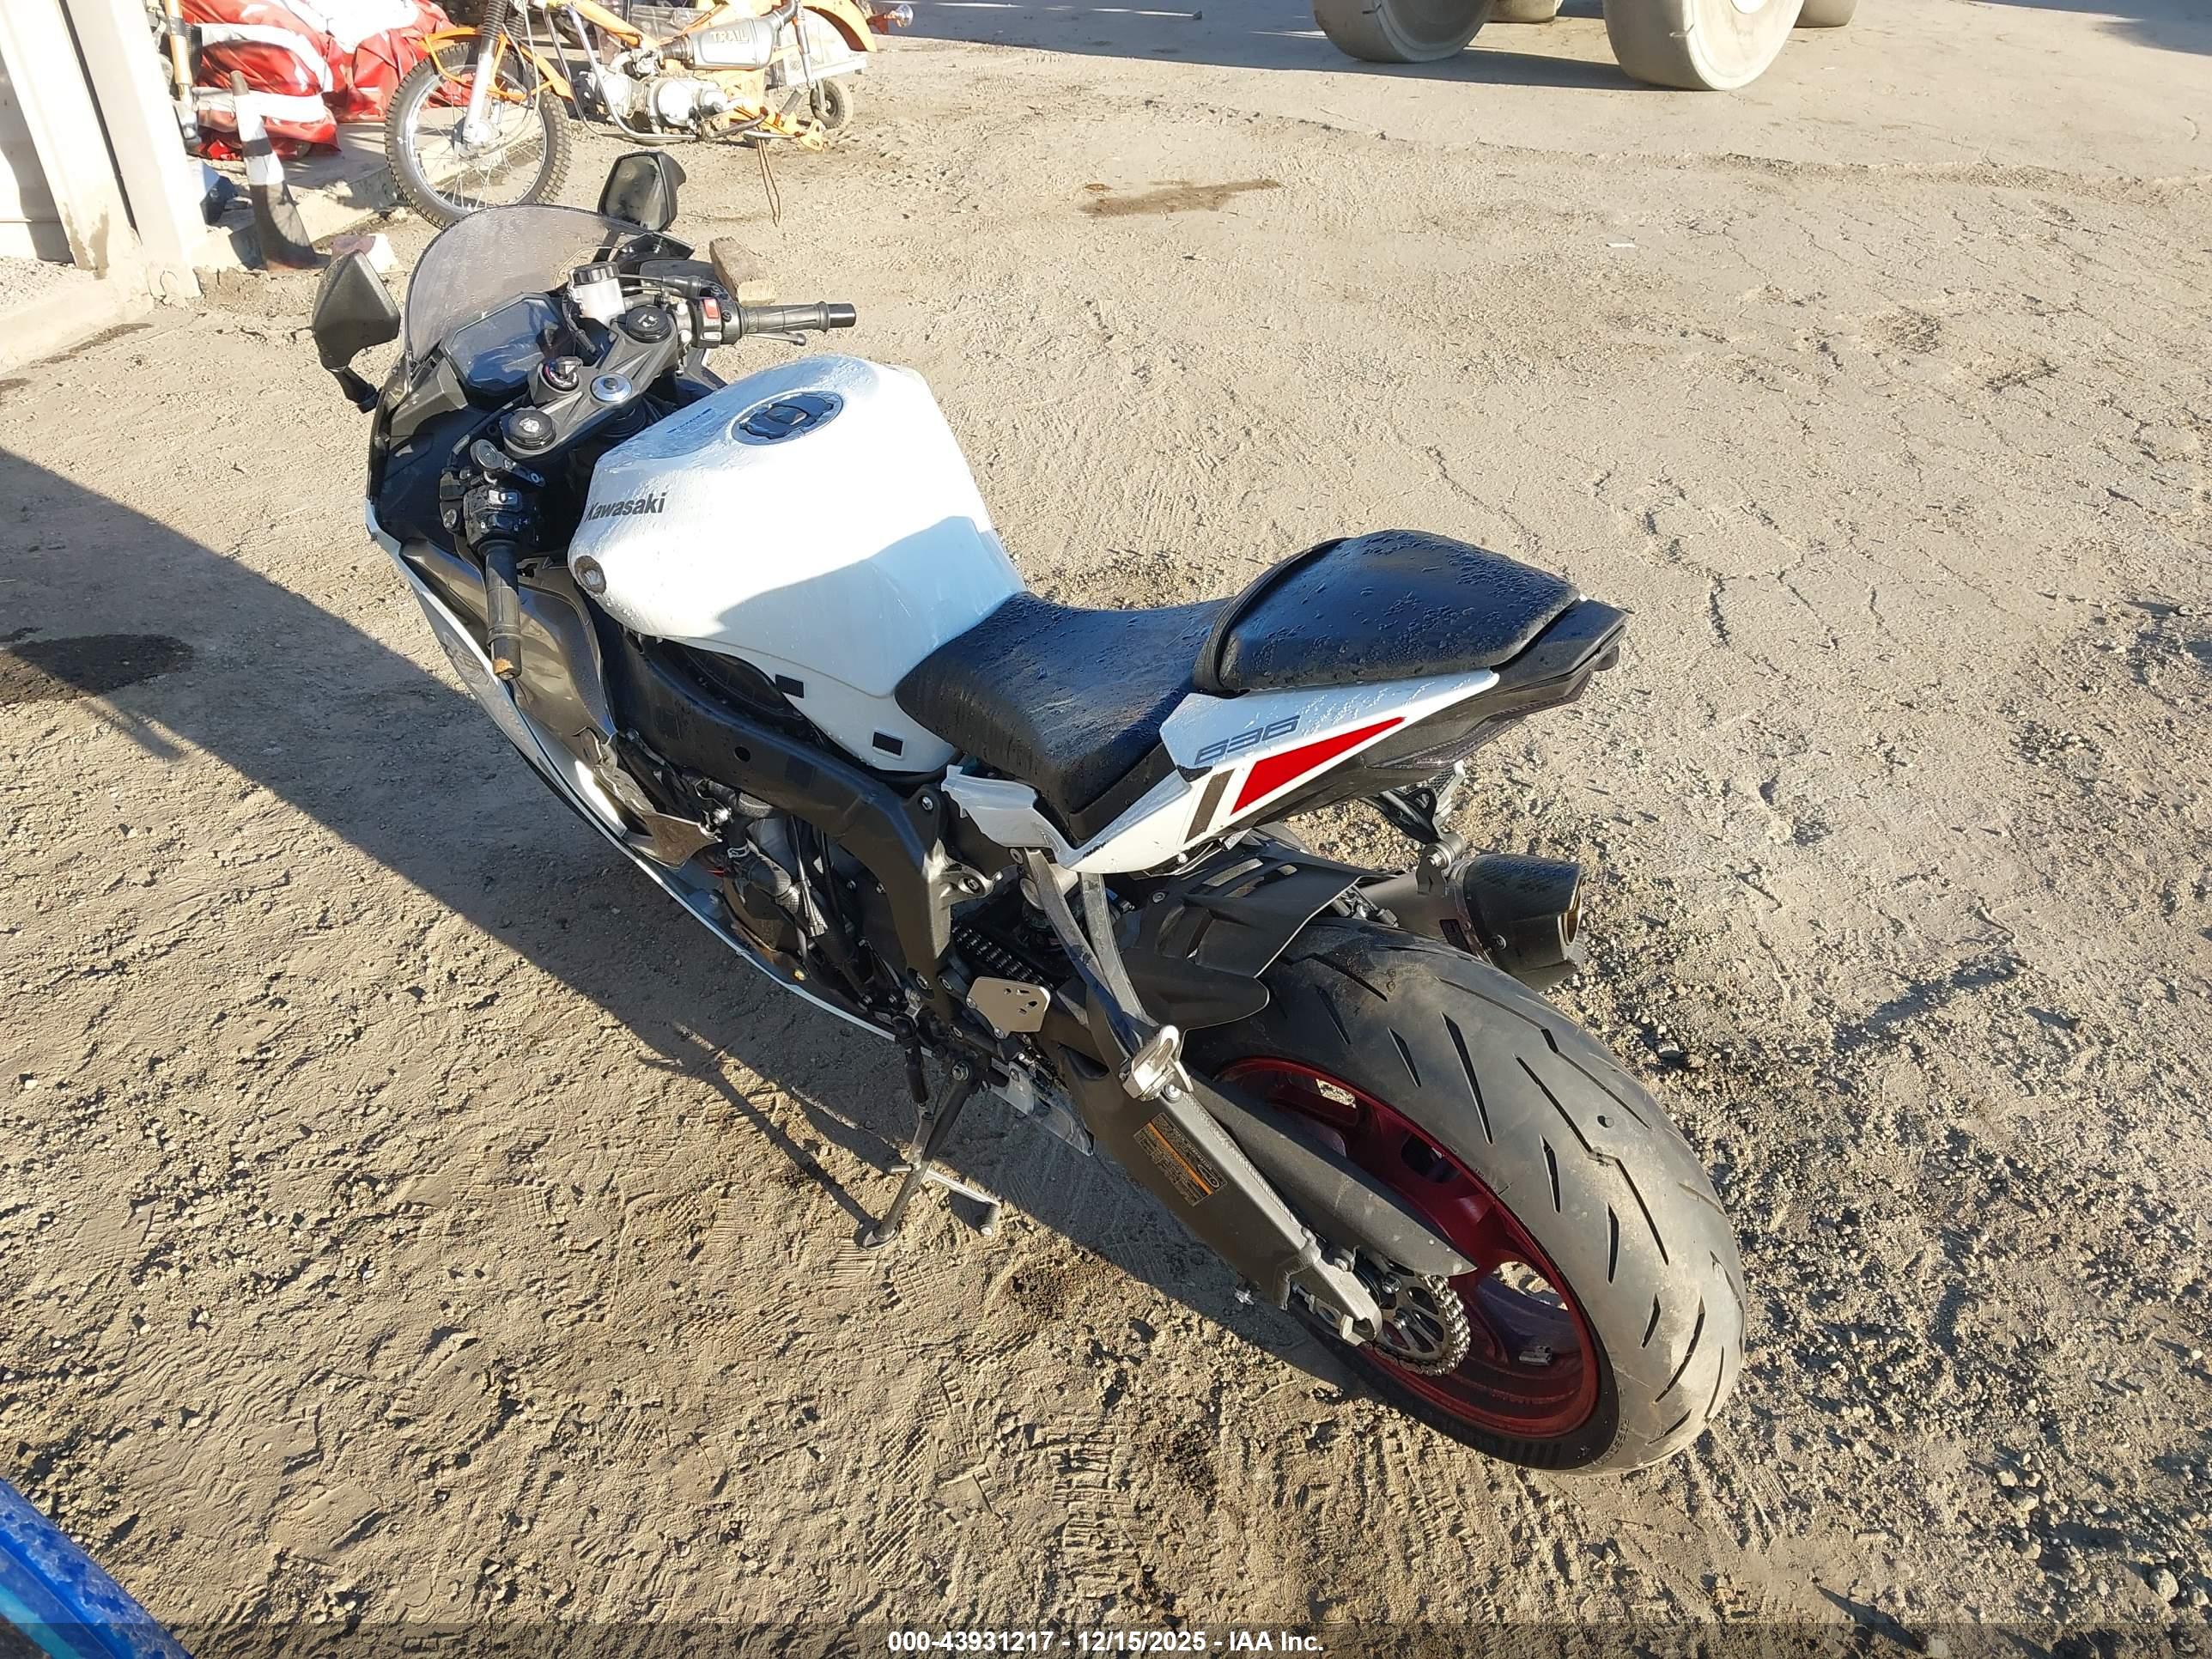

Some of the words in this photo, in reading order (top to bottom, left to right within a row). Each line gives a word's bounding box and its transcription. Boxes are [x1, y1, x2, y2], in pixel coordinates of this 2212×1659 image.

[709, 29, 750, 44] TRAIL
[585, 492, 666, 522] Kawasaki
[1194, 714, 1301, 766] 636
